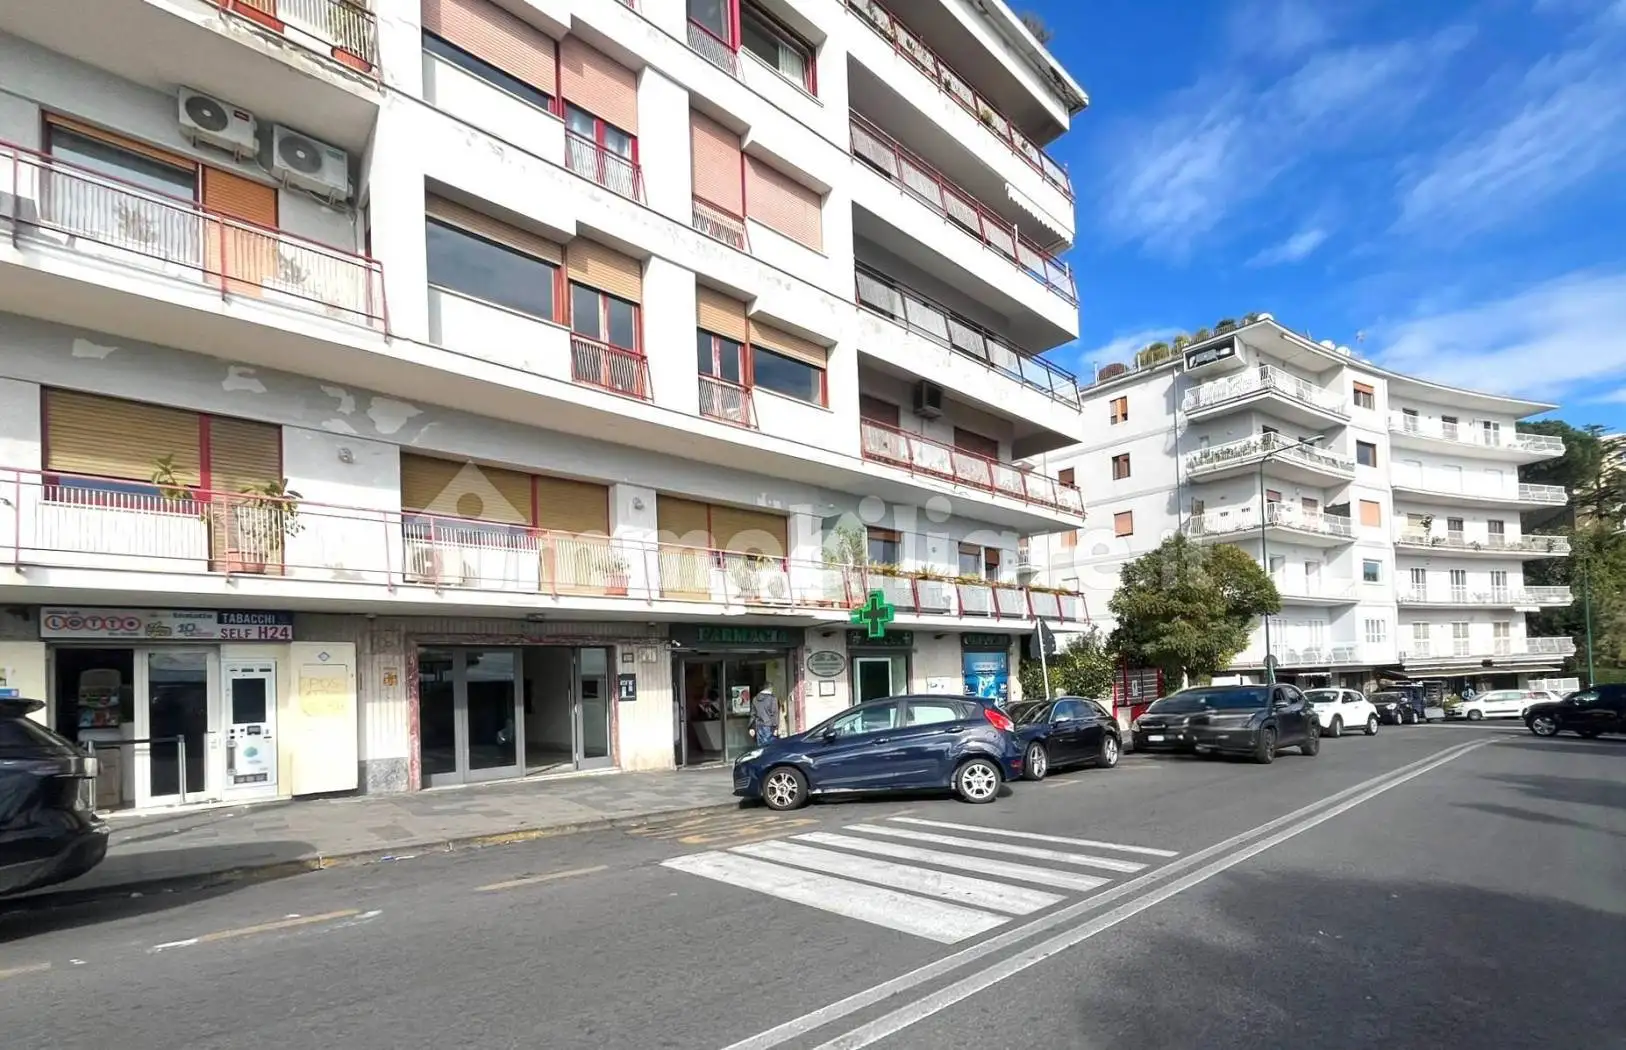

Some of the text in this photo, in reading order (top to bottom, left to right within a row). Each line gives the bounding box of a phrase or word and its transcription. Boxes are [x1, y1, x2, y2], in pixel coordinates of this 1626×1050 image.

[221, 613, 275, 624] TABACCHI
[220, 628, 252, 640] SELF
[258, 626, 289, 640] H24
